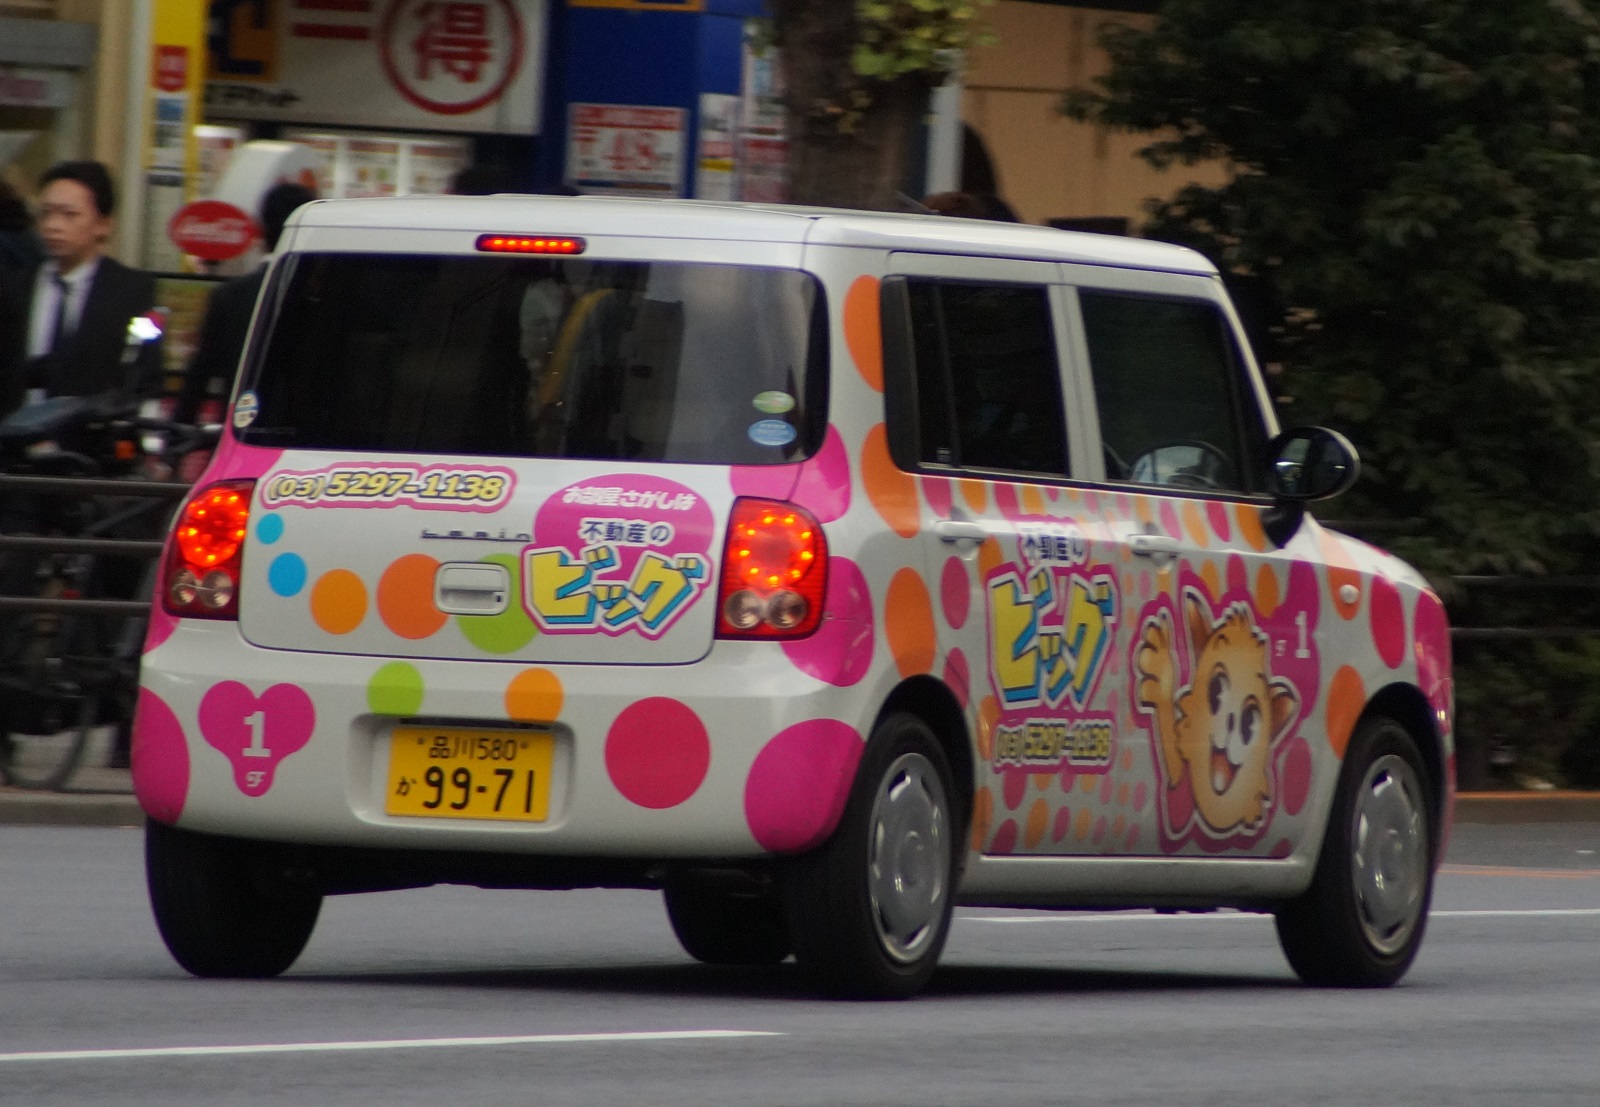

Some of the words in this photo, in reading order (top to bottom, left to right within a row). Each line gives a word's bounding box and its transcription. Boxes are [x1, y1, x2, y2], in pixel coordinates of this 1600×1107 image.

[269, 470, 505, 500] (03)5297-1138
[582, 520, 672, 544] 不動産の
[529, 544, 704, 631] ビッグ
[991, 568, 1114, 704] ビッグ
[242, 711, 271, 757] 1
[422, 765, 535, 814] 99-71
